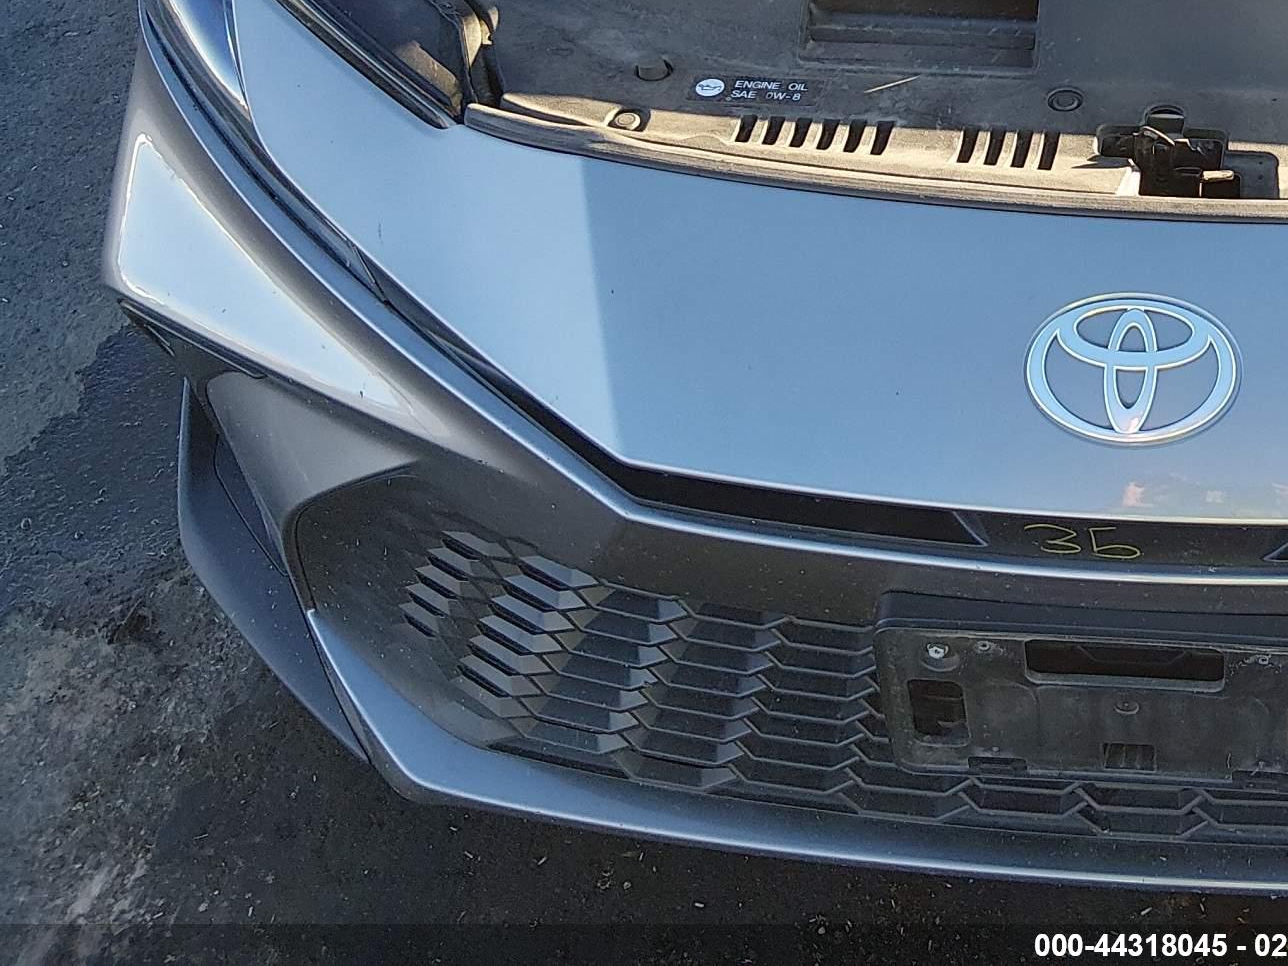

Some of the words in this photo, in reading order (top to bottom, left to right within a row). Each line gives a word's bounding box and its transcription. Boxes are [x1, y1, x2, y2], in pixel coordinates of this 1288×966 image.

[734, 80, 781, 90] ENGINE
[788, 82, 808, 91] OIL
[730, 89, 757, 99] SAE
[765, 92, 801, 101] 0W-8
[1023, 523, 1140, 559] 35
